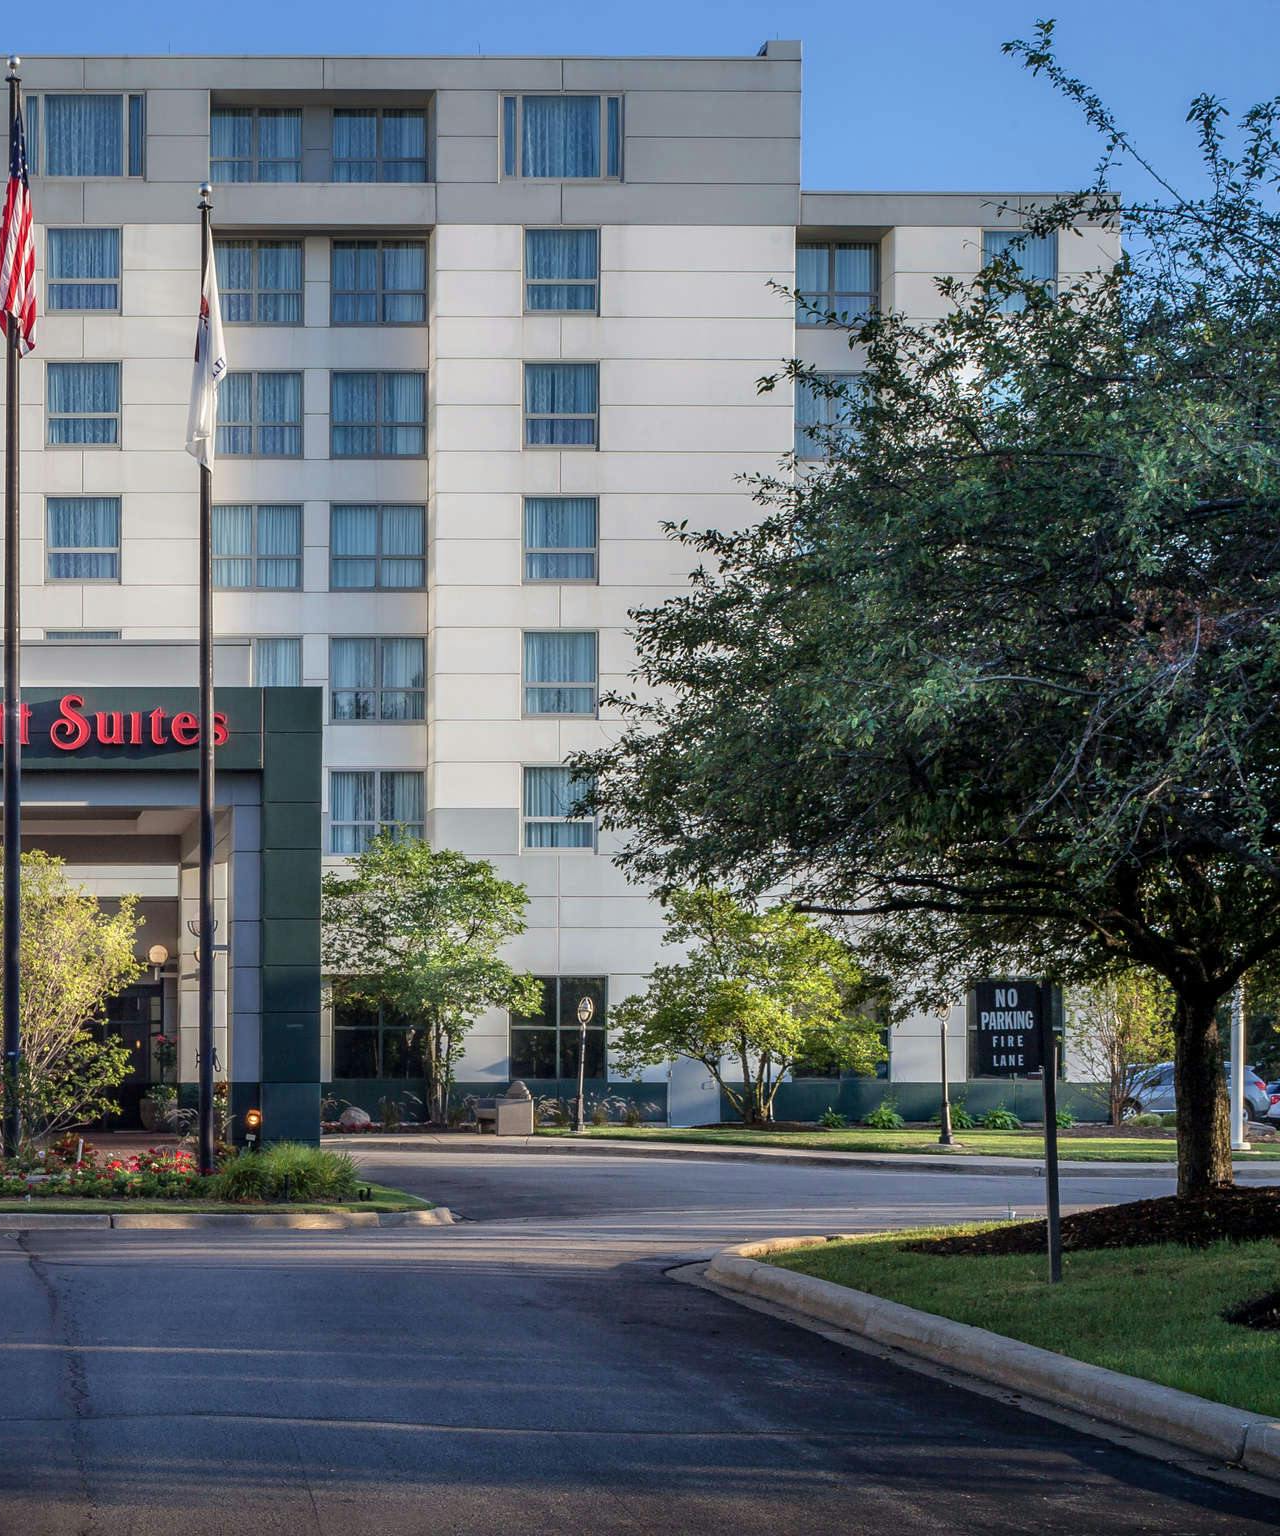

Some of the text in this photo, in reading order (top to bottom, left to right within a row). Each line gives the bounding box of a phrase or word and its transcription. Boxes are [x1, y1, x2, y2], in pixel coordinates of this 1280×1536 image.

[50, 694, 230, 750] Suites
[995, 988, 1018, 1008] NO
[980, 1010, 1034, 1031] PARKING
[992, 1035, 1024, 1048] FIRE
[992, 1054, 1024, 1067] LANE
